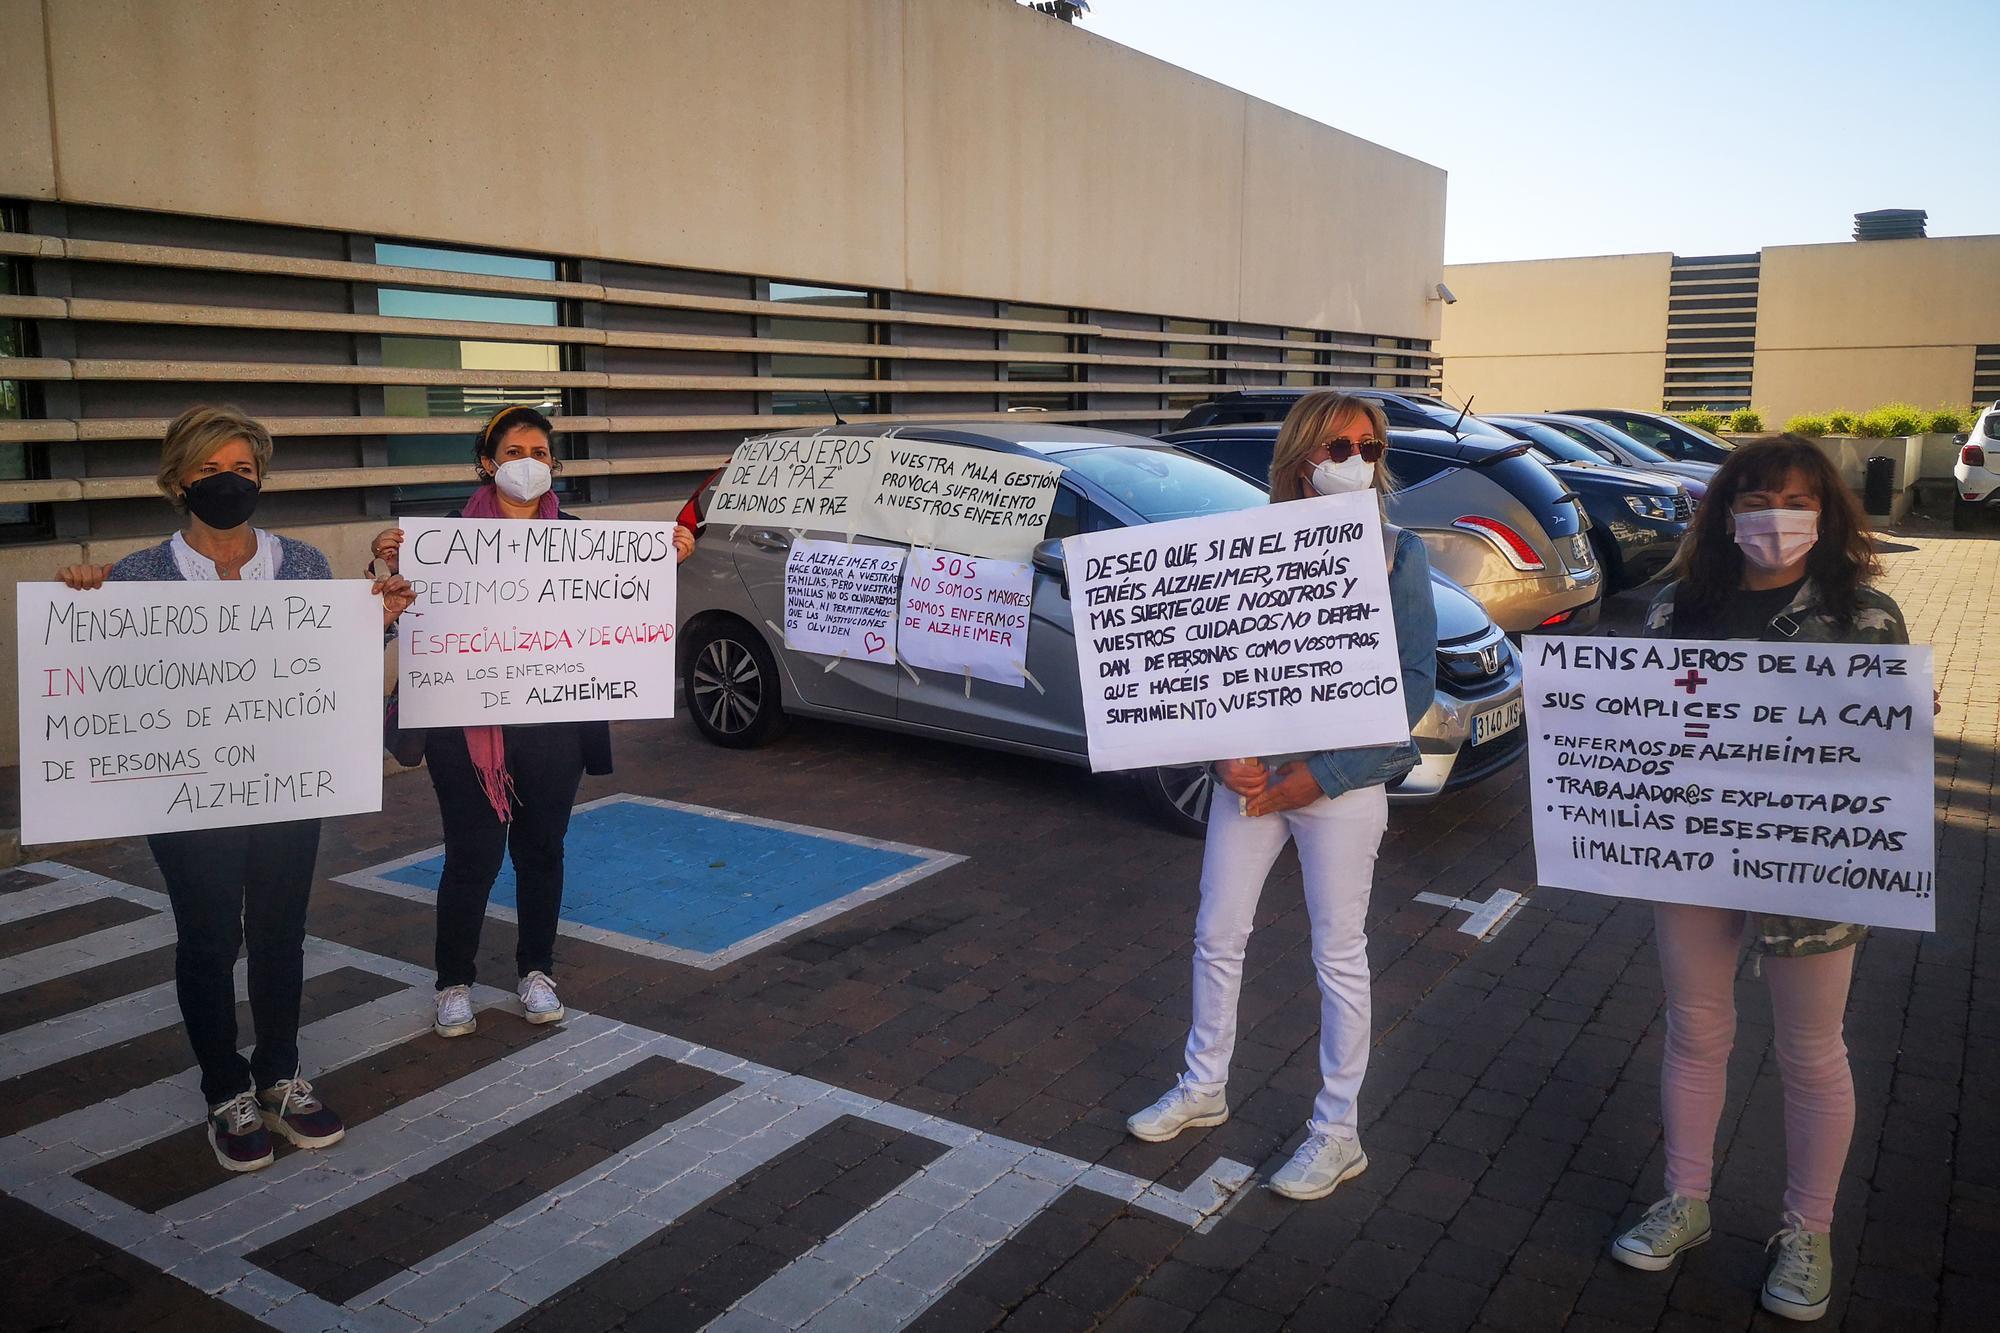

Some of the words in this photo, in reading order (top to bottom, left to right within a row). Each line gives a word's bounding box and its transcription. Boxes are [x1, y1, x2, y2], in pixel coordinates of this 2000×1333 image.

[737, 439, 874, 465] MENSAJEROS
[732, 465, 756, 485] DE
[757, 465, 778, 488] LA
[890, 450, 955, 476] VUESTRA
[961, 462, 998, 485] MALA
[1004, 471, 1060, 490] GESTIÓN
[716, 493, 787, 514] DEJADNOS
[792, 497, 816, 514] EN
[820, 496, 848, 516] PAZ
[882, 472, 939, 494] PROVOCA
[942, 483, 1036, 510] SUFRIMIENTO
[874, 493, 883, 505] A
[886, 494, 964, 518] NUESTROS
[964, 506, 1047, 527] ENFERMOS
[414, 528, 501, 565] CAM
[525, 527, 668, 563] MENSAJEROS
[792, 551, 805, 562] EL
[806, 552, 879, 570] ALZHEIMER
[881, 560, 898, 571] OS
[1085, 548, 1158, 582] DESEO
[1204, 539, 1225, 561] SI
[1228, 536, 1255, 559] EN
[1258, 531, 1287, 555] EL
[1293, 522, 1364, 552] FUTURO
[788, 564, 810, 574] HACE
[811, 565, 844, 578] OLVIDAR
[847, 569, 855, 579] A
[860, 572, 899, 584] VUESTRAS
[931, 556, 977, 579] SOS
[1085, 577, 1147, 607] TENÉIS
[1151, 565, 1273, 597] ALZHEIMER,
[1276, 548, 1350, 582] TENGÁIS
[410, 579, 530, 606] PEDIMOS
[538, 573, 650, 603] ATENCIÓN
[787, 586, 824, 599] FAMILIAS
[826, 591, 837, 600] NO
[839, 592, 849, 601] OS
[831, 578, 854, 590] PERO
[855, 582, 898, 595] VUESTRAS
[910, 576, 931, 592] NO
[935, 581, 983, 601] SOMOS
[987, 589, 1031, 607] MAYORES
[1090, 608, 1126, 630] MAS
[1130, 598, 1192, 624] SUERTE
[1190, 594, 1231, 616] QUE
[1237, 581, 1338, 611] NOSOTROS
[1341, 577, 1359, 599] Y
[45, 600, 208, 645] MENSAJEROS
[218, 604, 241, 633] DE
[250, 605, 274, 632] LA
[284, 596, 332, 631] PAZ
[788, 608, 803, 618] QUE
[806, 611, 819, 620] LAS
[824, 614, 887, 628] INSTITUCIONES
[819, 602, 830, 612] NI
[833, 603, 892, 618] PERMITIREMOS
[907, 598, 945, 617] SOMOS
[950, 607, 1025, 628] ENFERMOS
[411, 626, 573, 655] ESPECIALIZADA
[577, 629, 587, 644] Y
[590, 626, 611, 646] DE
[615, 623, 674, 644] CALIDAD
[786, 619, 798, 629] OS
[807, 622, 851, 636] OLVIDEN
[904, 616, 921, 629] DE
[927, 620, 1012, 647] ALZHEIMER
[1093, 626, 1176, 654] VUESTROS
[1185, 612, 1283, 642] CUIDADOS
[1280, 611, 1312, 631] NO
[1099, 658, 1131, 678] DAN
[1144, 653, 1165, 672] DE
[1167, 645, 1239, 668] PERSONAS
[1245, 638, 1291, 659] COMO
[1293, 631, 1380, 654] VOSOTROS,
[1540, 641, 1748, 672] MENSAJEROS
[1757, 654, 1797, 674] DE
[1805, 654, 1836, 677] LA
[1847, 653, 1908, 679] PAZ
[41, 658, 257, 698] INVOLUCIONANDO
[273, 657, 322, 679] LOS
[409, 671, 455, 688] PARA
[466, 666, 499, 681] LOS
[506, 662, 585, 679] ENFERMOS
[1103, 682, 1139, 701] QUE
[1149, 668, 1210, 695] HACÉIS
[1222, 668, 1249, 687] DE
[1254, 660, 1343, 683] NUESTRO
[481, 690, 511, 709] DE
[526, 676, 639, 704] ALZHEIMER
[1106, 698, 1217, 725] SUFRIMIENTO
[1218, 686, 1302, 713] VUESTRO
[1310, 675, 1398, 702] NEGOCIO
[1541, 692, 1586, 710] SUS
[1595, 696, 1741, 719] COMPLICES
[1753, 705, 1788, 724] DE
[1797, 706, 1827, 726] LA
[45, 708, 171, 741] MODELOS
[186, 706, 212, 728] DE
[224, 688, 337, 725] ATENCIÓN
[1478, 710, 1502, 739] 3140
[1505, 702, 1518, 728] JXS
[42, 760, 75, 783] DE
[90, 748, 201, 778] PERSONAS
[214, 744, 256, 767] CON
[1554, 735, 1667, 756] ENFERMOS
[1667, 743, 1697, 758] DE
[1698, 736, 1861, 761] ALZHEIMER
[1557, 751, 1675, 776] OLVIDADOS
[167, 770, 336, 814] ALZHEIMER
[1555, 776, 1715, 805] TRABAJADOR@S
[1721, 789, 1892, 815] EXPLOTADOS
[1558, 803, 1675, 831] FAMILIAS
[1685, 816, 1908, 852] DESESPERADAS
